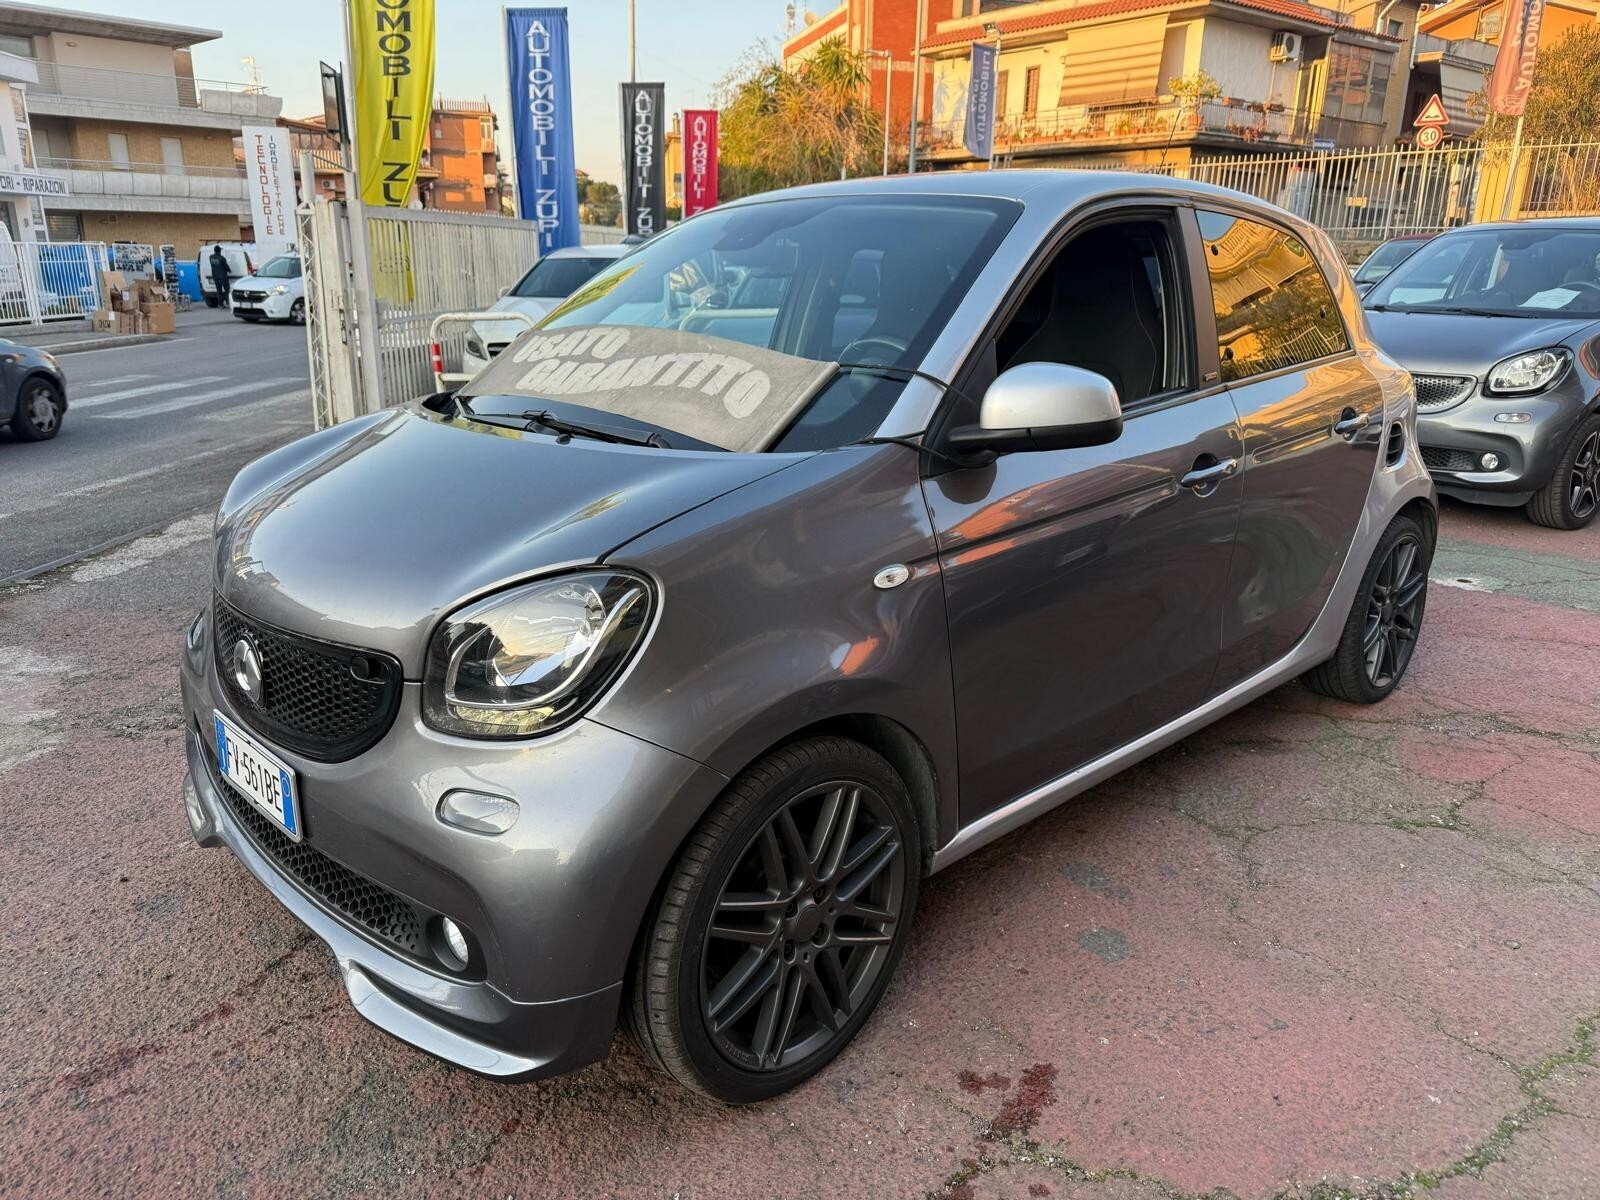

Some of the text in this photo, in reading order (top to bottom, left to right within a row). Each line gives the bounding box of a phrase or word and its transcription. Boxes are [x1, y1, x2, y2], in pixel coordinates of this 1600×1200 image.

[526, 20, 559, 247] AUTOMOBILI ZUPI
[635, 90, 653, 235] AUTOMOBILI ZUP
[692, 115, 708, 199] AUTOMOBILI
[1423, 131, 1437, 142] 30
[0, 175, 14, 190] ORI
[23, 177, 66, 194] RIPARAZIONI
[255, 135, 273, 235] TECNOLOGIE
[269, 136, 286, 235] IDROELETTRICHE
[513, 327, 630, 363] USATO
[516, 352, 771, 418] GARANTITO
